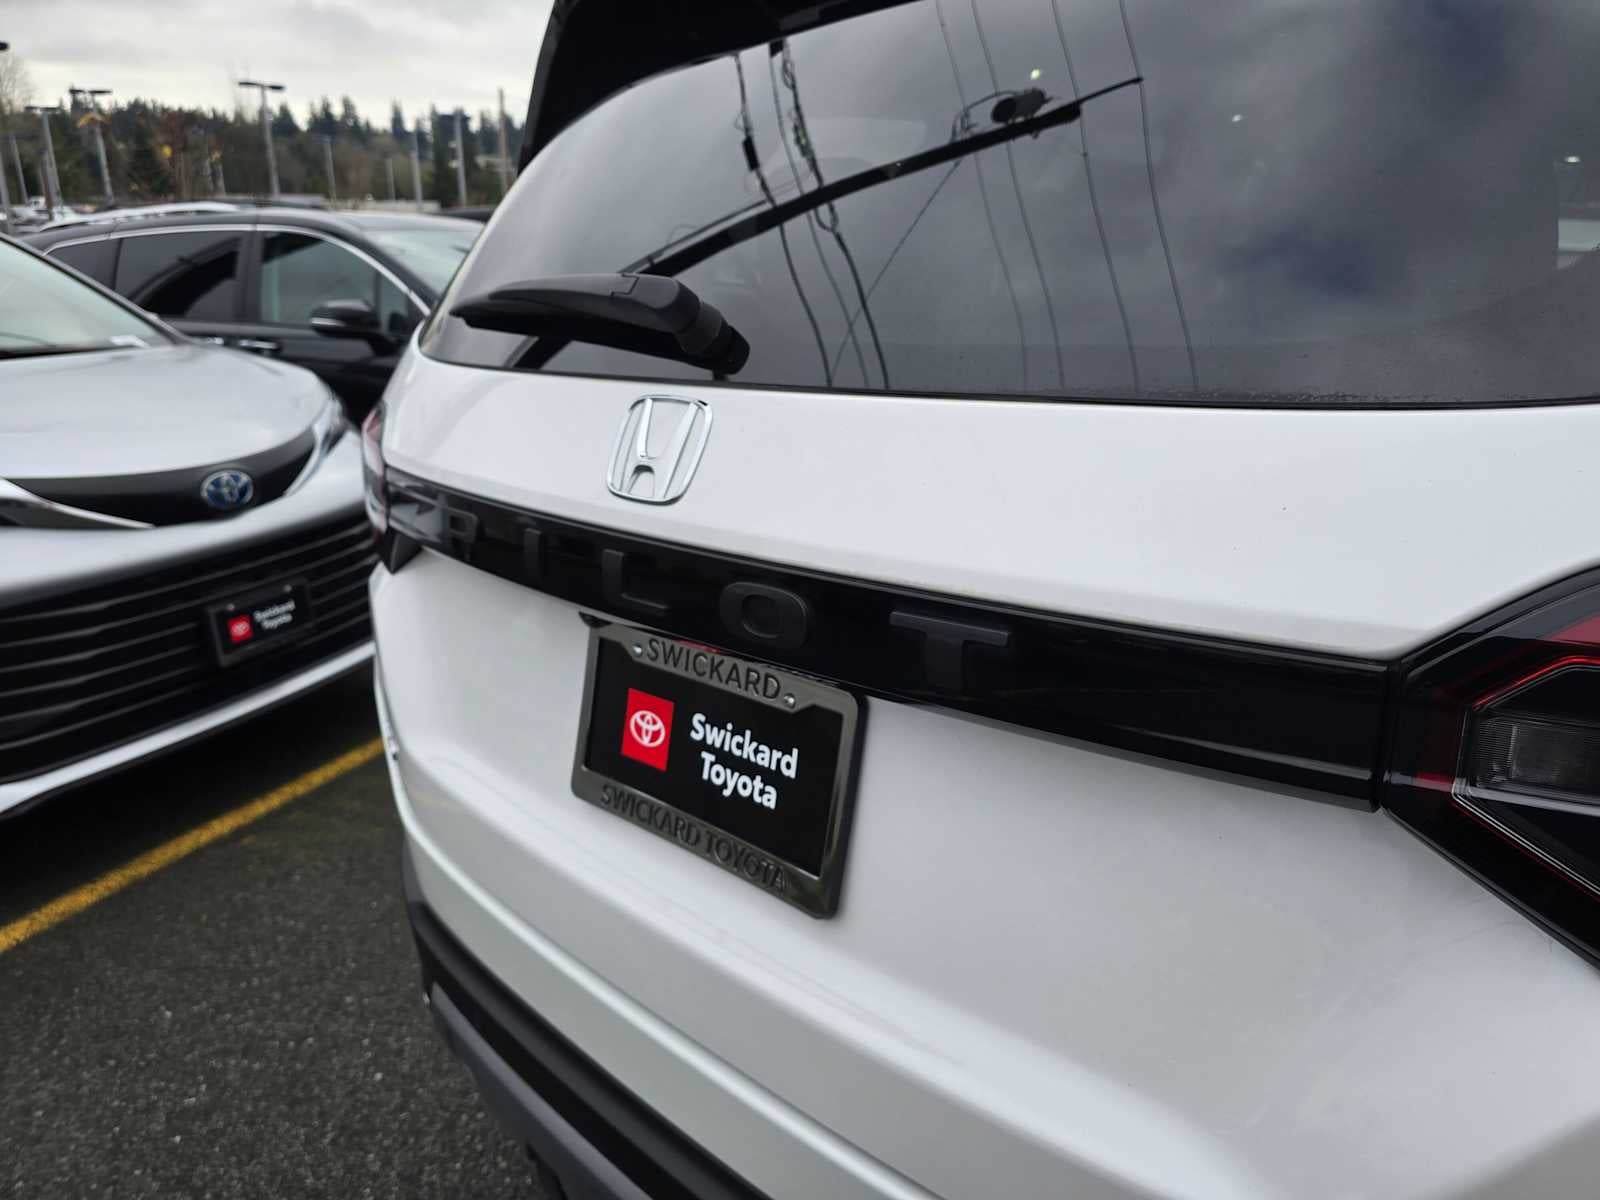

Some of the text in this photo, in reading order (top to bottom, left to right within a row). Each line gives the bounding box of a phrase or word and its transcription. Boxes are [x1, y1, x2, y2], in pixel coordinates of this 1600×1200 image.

[436, 500, 1011, 696] PILOT
[645, 638, 782, 700] SWICKARD
[689, 712, 799, 779] Swickard
[699, 751, 778, 810] Toyota
[601, 783, 787, 890] SWICKARD TOYOTA
